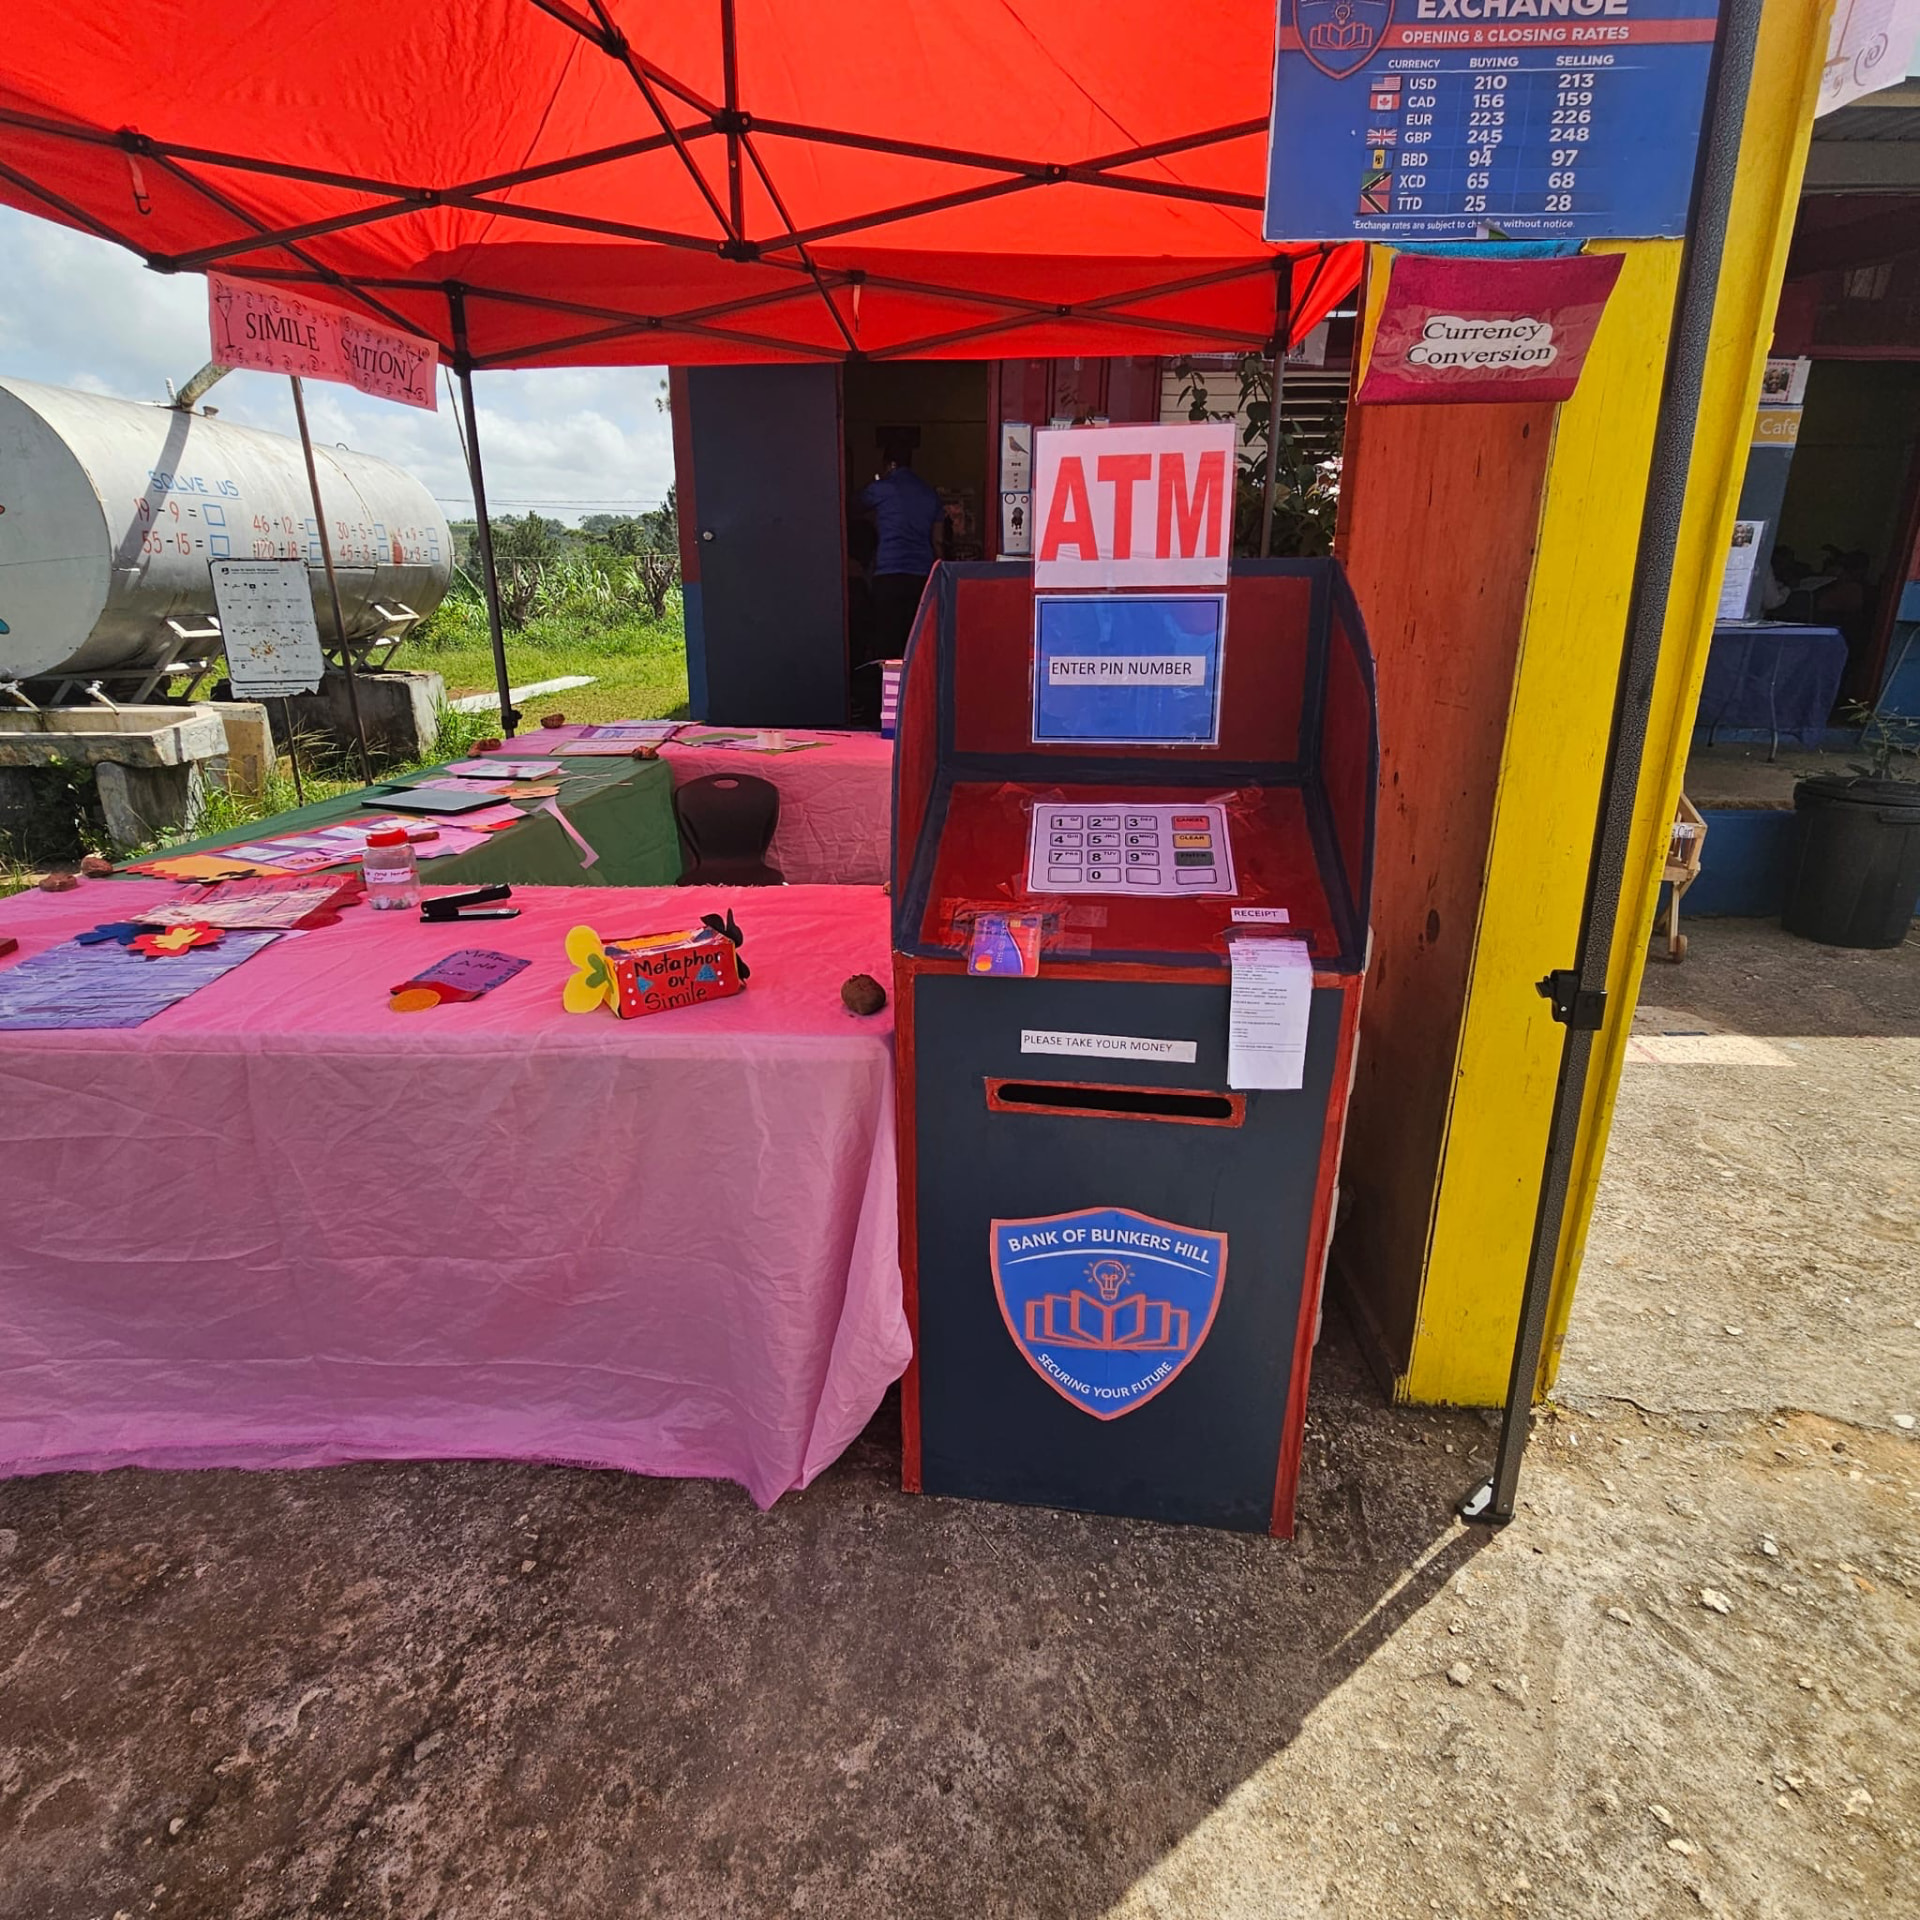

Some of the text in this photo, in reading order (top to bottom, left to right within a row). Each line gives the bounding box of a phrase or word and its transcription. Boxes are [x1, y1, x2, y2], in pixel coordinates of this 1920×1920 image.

[1417, 0, 1628, 18] EXCHANGE
[1402, 26, 1630, 44] OPENING & CLOSING RATES
[1388, 54, 1614, 69] CURRENCY BUYING SELLING
[1409, 73, 1595, 90] USD 210 213
[1407, 92, 1593, 108] CAD 156 159
[1406, 110, 1591, 126] EUR 223 226
[1404, 127, 1590, 144] GBP 245 248
[1401, 150, 1578, 167] BBD 94 97
[1399, 172, 1576, 189] XCD 65 68
[1397, 195, 1572, 212] TTD 25 28
[1392, 221, 1411, 230] rates
[1412, 222, 1425, 230] are
[1427, 220, 1456, 231] subject
[1457, 220, 1466, 229] to
[1503, 218, 1541, 228] without
[1424, 322, 1544, 341] Currency
[246, 312, 406, 382] SIMILE SATION
[1406, 345, 1551, 364] Conversion
[148, 471, 239, 496] SOLVE US
[1039, 451, 1225, 561] ATM
[1052, 662, 1192, 675] ENTER PIN NUMBER
[1056, 818, 1063, 827] 1
[1092, 818, 1102, 827] 2
[1129, 818, 1138, 827] 3
[1054, 835, 1064, 844] 4
[1092, 835, 1102, 844] 5
[1130, 835, 1139, 844] 6
[1054, 852, 1063, 861] 7
[1092, 852, 1102, 862] 8
[1130, 852, 1140, 862] 9
[1233, 909, 1278, 917] RECEIPT
[634, 950, 724, 980] Metaphor
[668, 975, 689, 988] or
[645, 982, 706, 1010] Simile
[1024, 1034, 1173, 1052] PLEASE TAKE YOUR MONEY
[1008, 1228, 1210, 1264] BANK OF BUNKERS HILL
[1038, 1352, 1172, 1398] SECURING YOUR FUTURE
